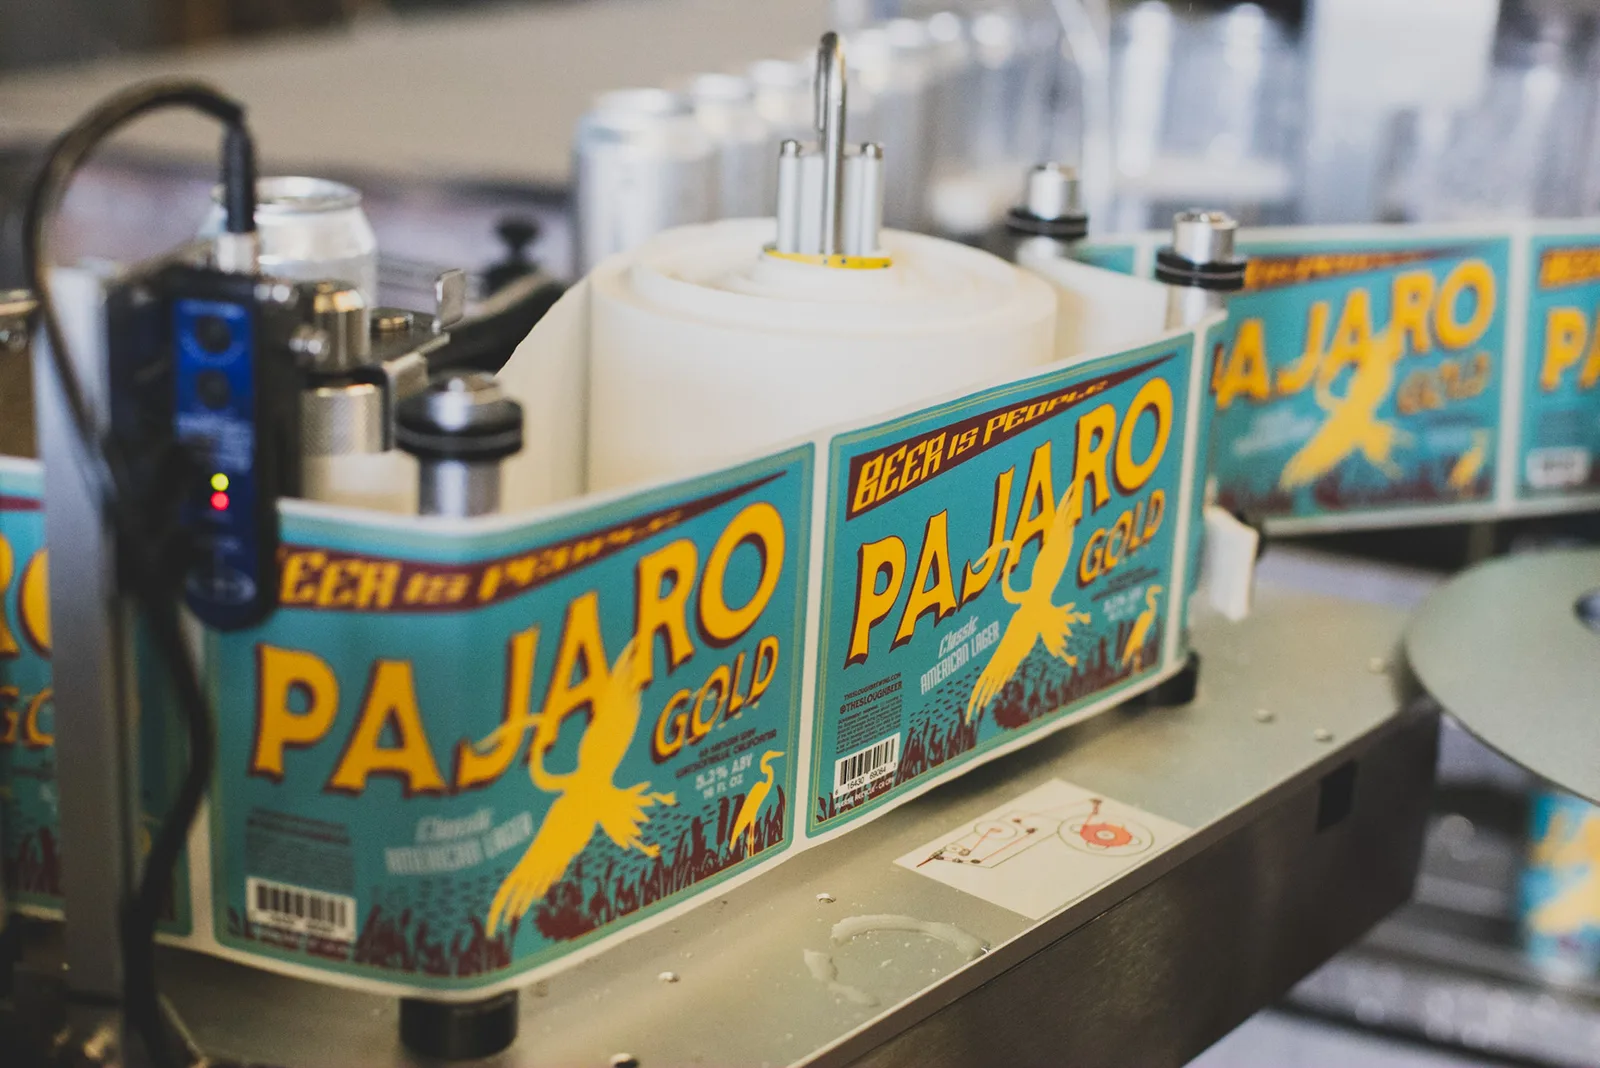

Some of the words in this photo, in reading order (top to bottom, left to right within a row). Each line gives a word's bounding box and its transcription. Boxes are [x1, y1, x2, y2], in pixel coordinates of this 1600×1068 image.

[1210, 258, 1497, 411] AJARO
[851, 432, 946, 514] BEER
[946, 427, 979, 461] IS
[844, 376, 1174, 670] PAJARO
[1076, 488, 1165, 590] GOLD
[276, 550, 400, 610] EER
[247, 501, 787, 798] PAJARO
[920, 642, 970, 696] AMERICAN
[971, 620, 1000, 659] LAGER
[938, 615, 980, 659] Classic
[650, 634, 780, 765] GOLD
[839, 680, 903, 715] @THESLOUGHBEER
[846, 776, 866, 790] 16430
